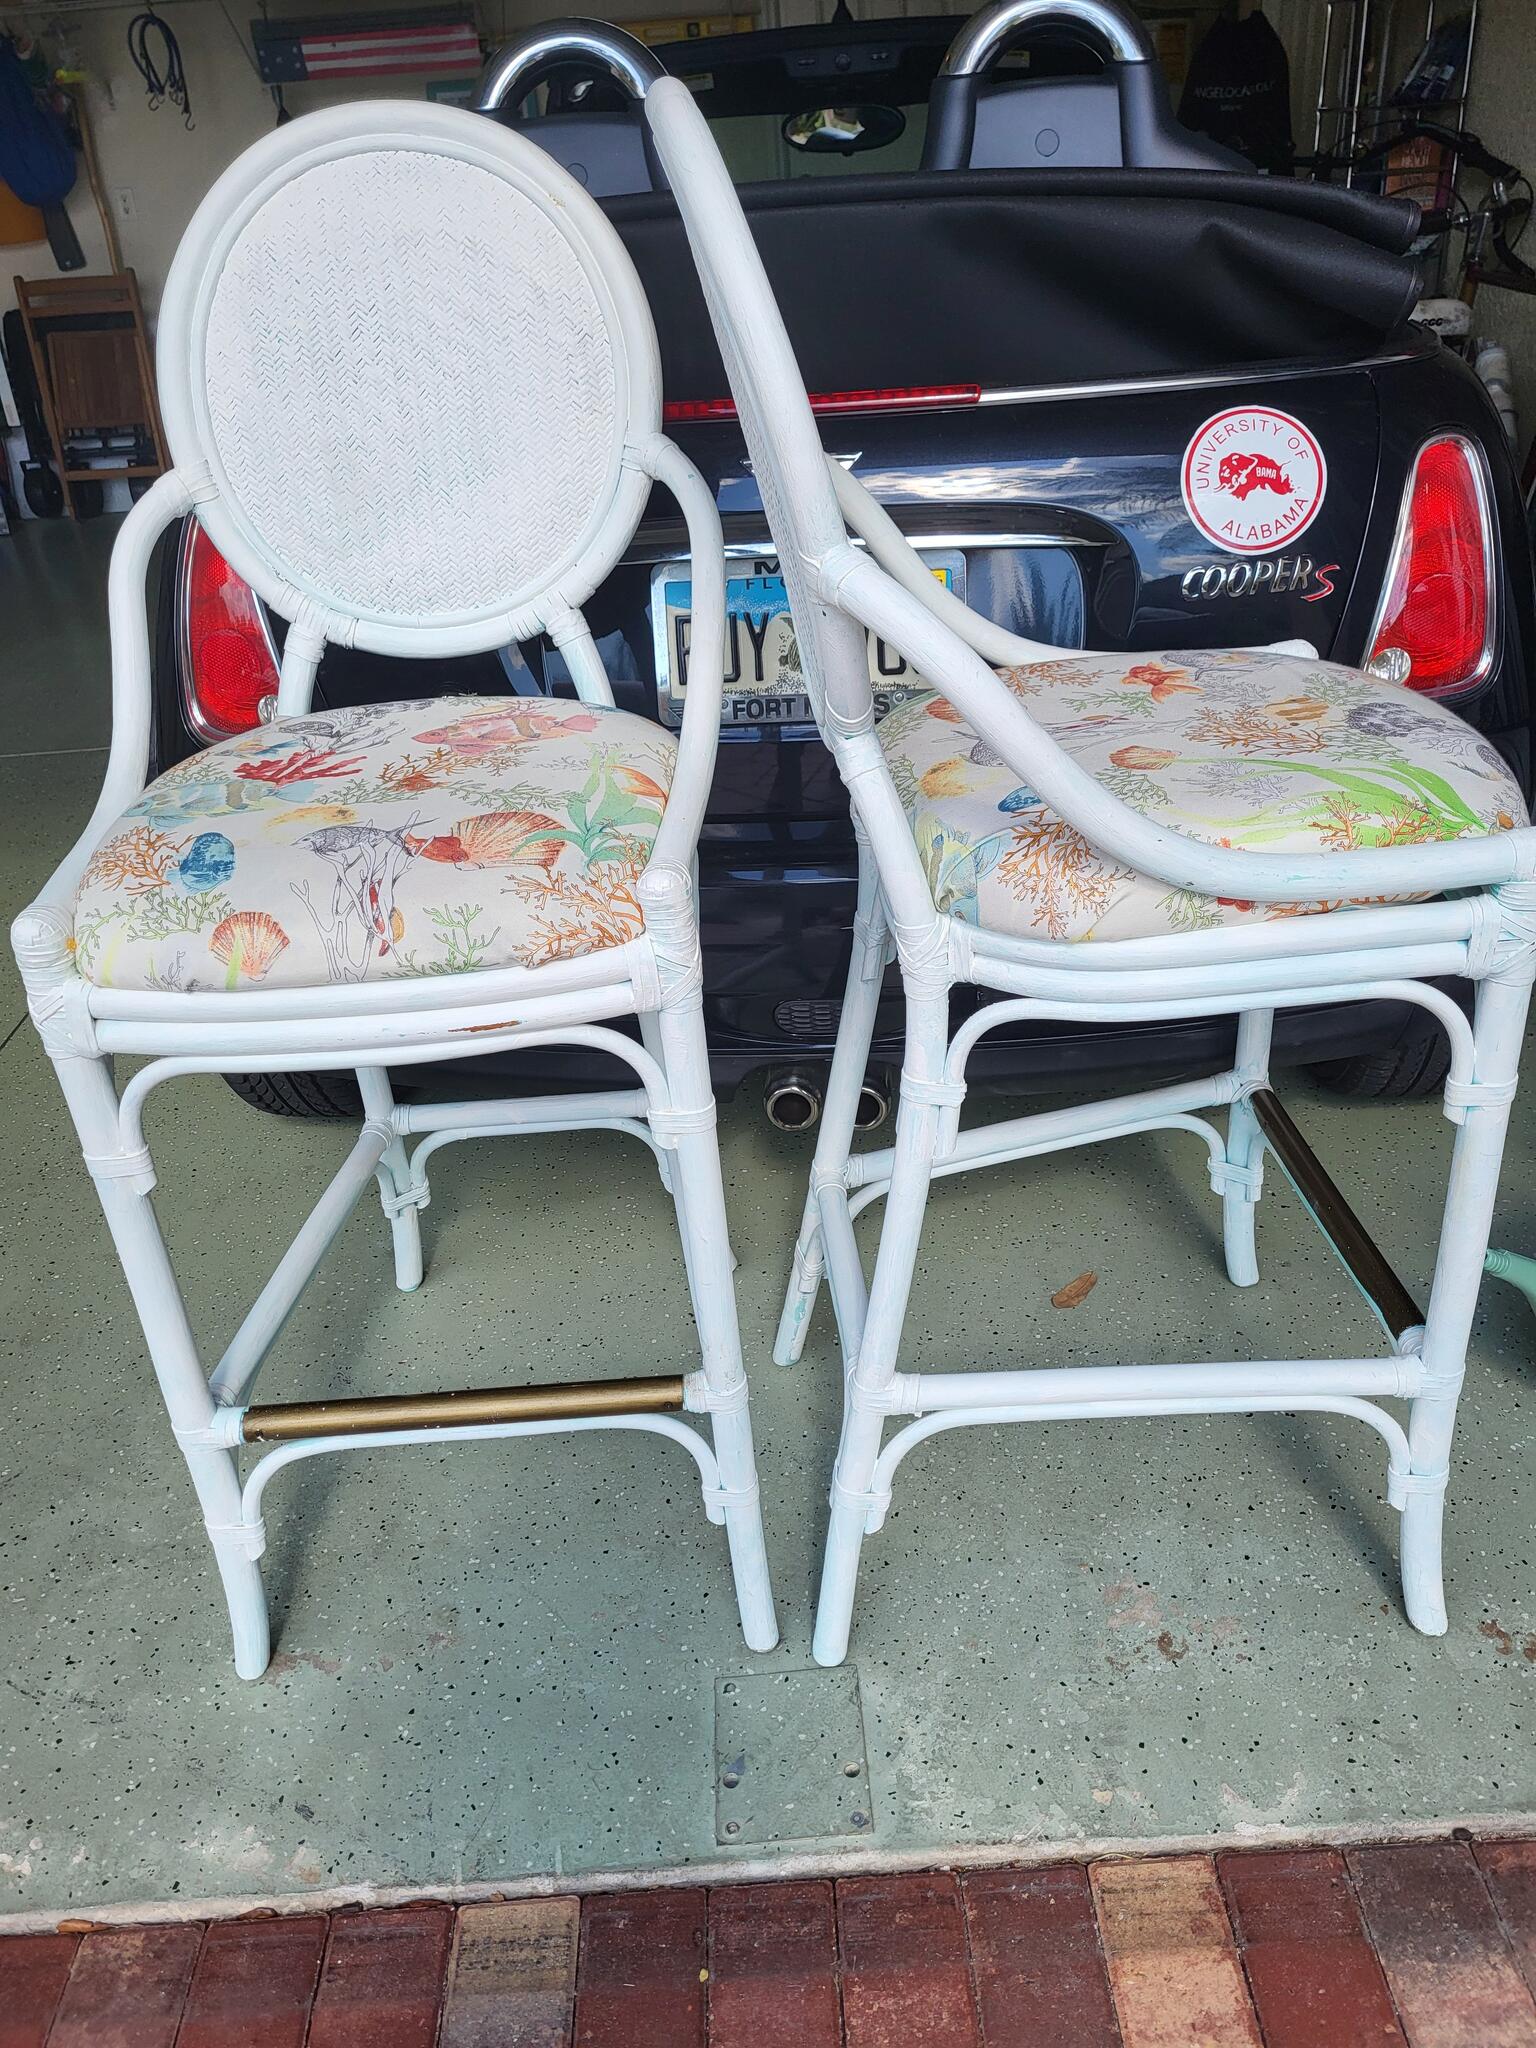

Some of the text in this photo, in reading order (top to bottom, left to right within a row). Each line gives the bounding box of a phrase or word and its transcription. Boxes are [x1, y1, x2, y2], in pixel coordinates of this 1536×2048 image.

[1197, 418, 1309, 490] UNIVERSITY OF
[1255, 466, 1277, 480] BAMA
[1220, 497, 1309, 541] ALABAMA
[1181, 554, 1341, 602] COOPER S
[732, 697, 796, 720] FORT
